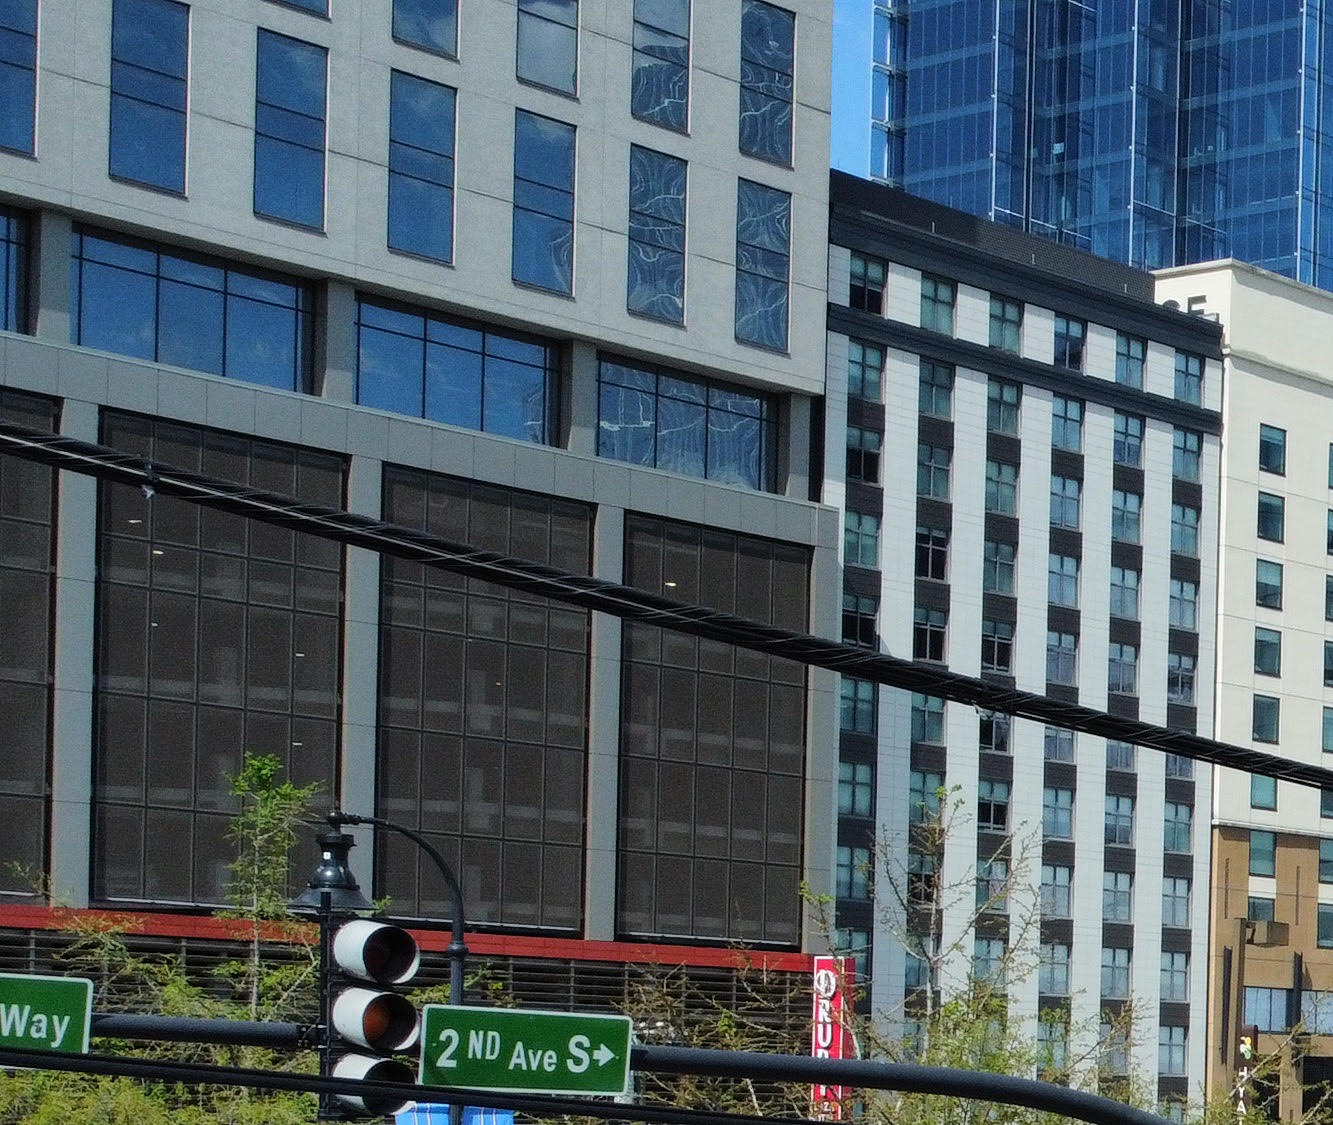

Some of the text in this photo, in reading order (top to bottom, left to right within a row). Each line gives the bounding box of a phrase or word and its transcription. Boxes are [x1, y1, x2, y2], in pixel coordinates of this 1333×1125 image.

[0, 1003, 70, 1048] Way
[508, 1040, 558, 1072] Ave
[566, 1034, 592, 1074] S
